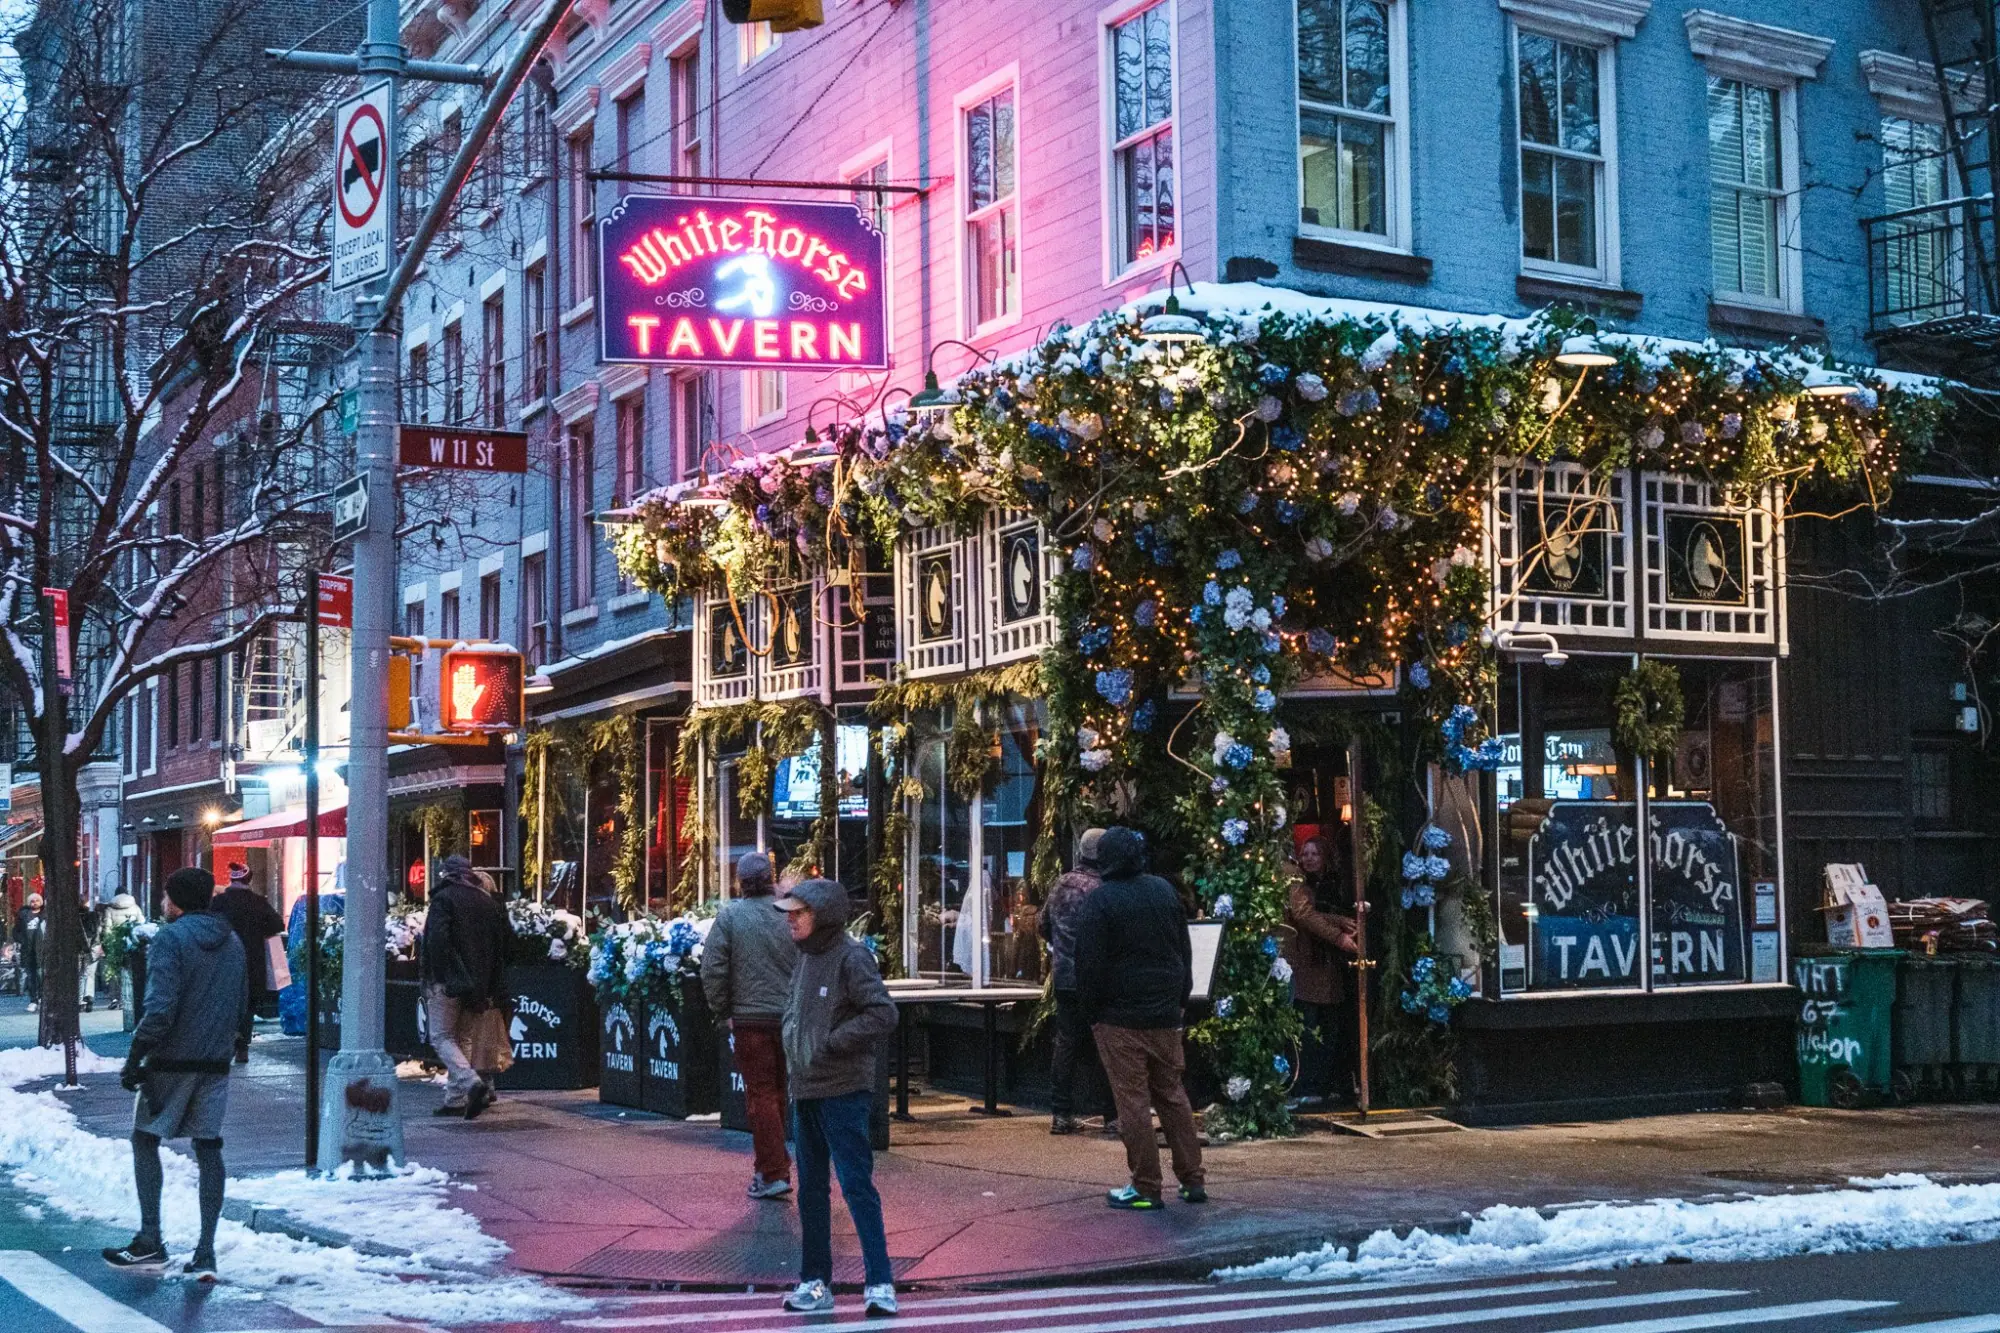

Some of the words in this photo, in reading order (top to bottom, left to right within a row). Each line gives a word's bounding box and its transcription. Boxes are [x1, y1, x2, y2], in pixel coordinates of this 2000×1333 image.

[337, 236, 360, 260] EXCEPT
[363, 228, 384, 249] LOCAL
[621, 208, 743, 286] White
[341, 250, 379, 278] DELIVERIES
[627, 316, 862, 361] TAVERN
[430, 438, 445, 462] W
[453, 439, 467, 465] 11
[476, 440, 495, 467] St
[1534, 816, 1636, 911] White
[1552, 929, 1725, 979] TAVERN
[511, 1042, 558, 1059] VERN
[606, 1051, 634, 1073] TAVERN
[649, 1058, 679, 1081] TAVERN
